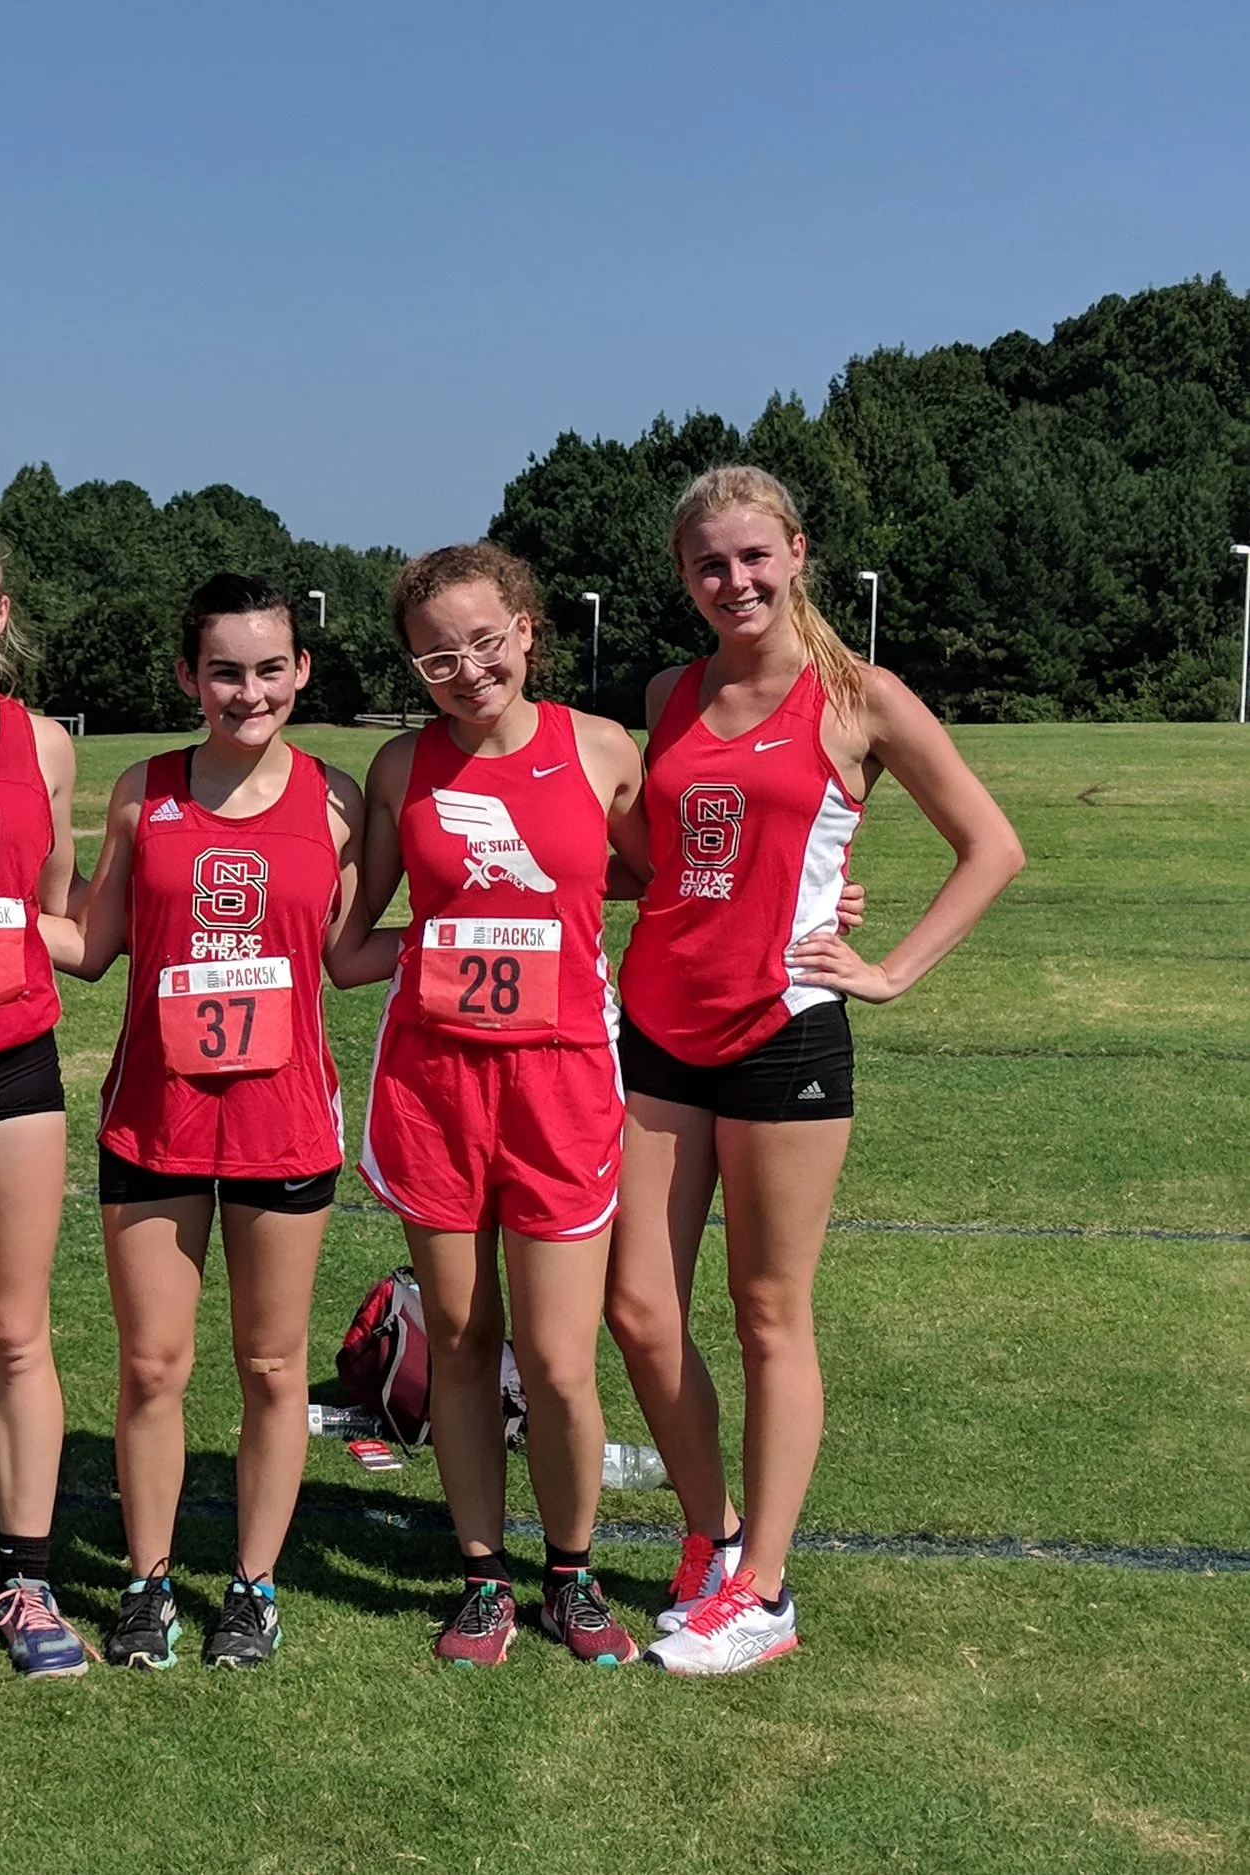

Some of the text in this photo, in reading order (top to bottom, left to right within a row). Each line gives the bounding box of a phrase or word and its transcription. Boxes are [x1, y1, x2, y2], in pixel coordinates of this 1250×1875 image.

[149, 811, 184, 823] adidas
[469, 839, 526, 853] NC STATE
[710, 871, 735, 887] XC
[191, 931, 263, 949] CLUB XC
[208, 945, 261, 961] TRACK
[458, 955, 521, 1015] 28
[197, 997, 256, 1058] 37
